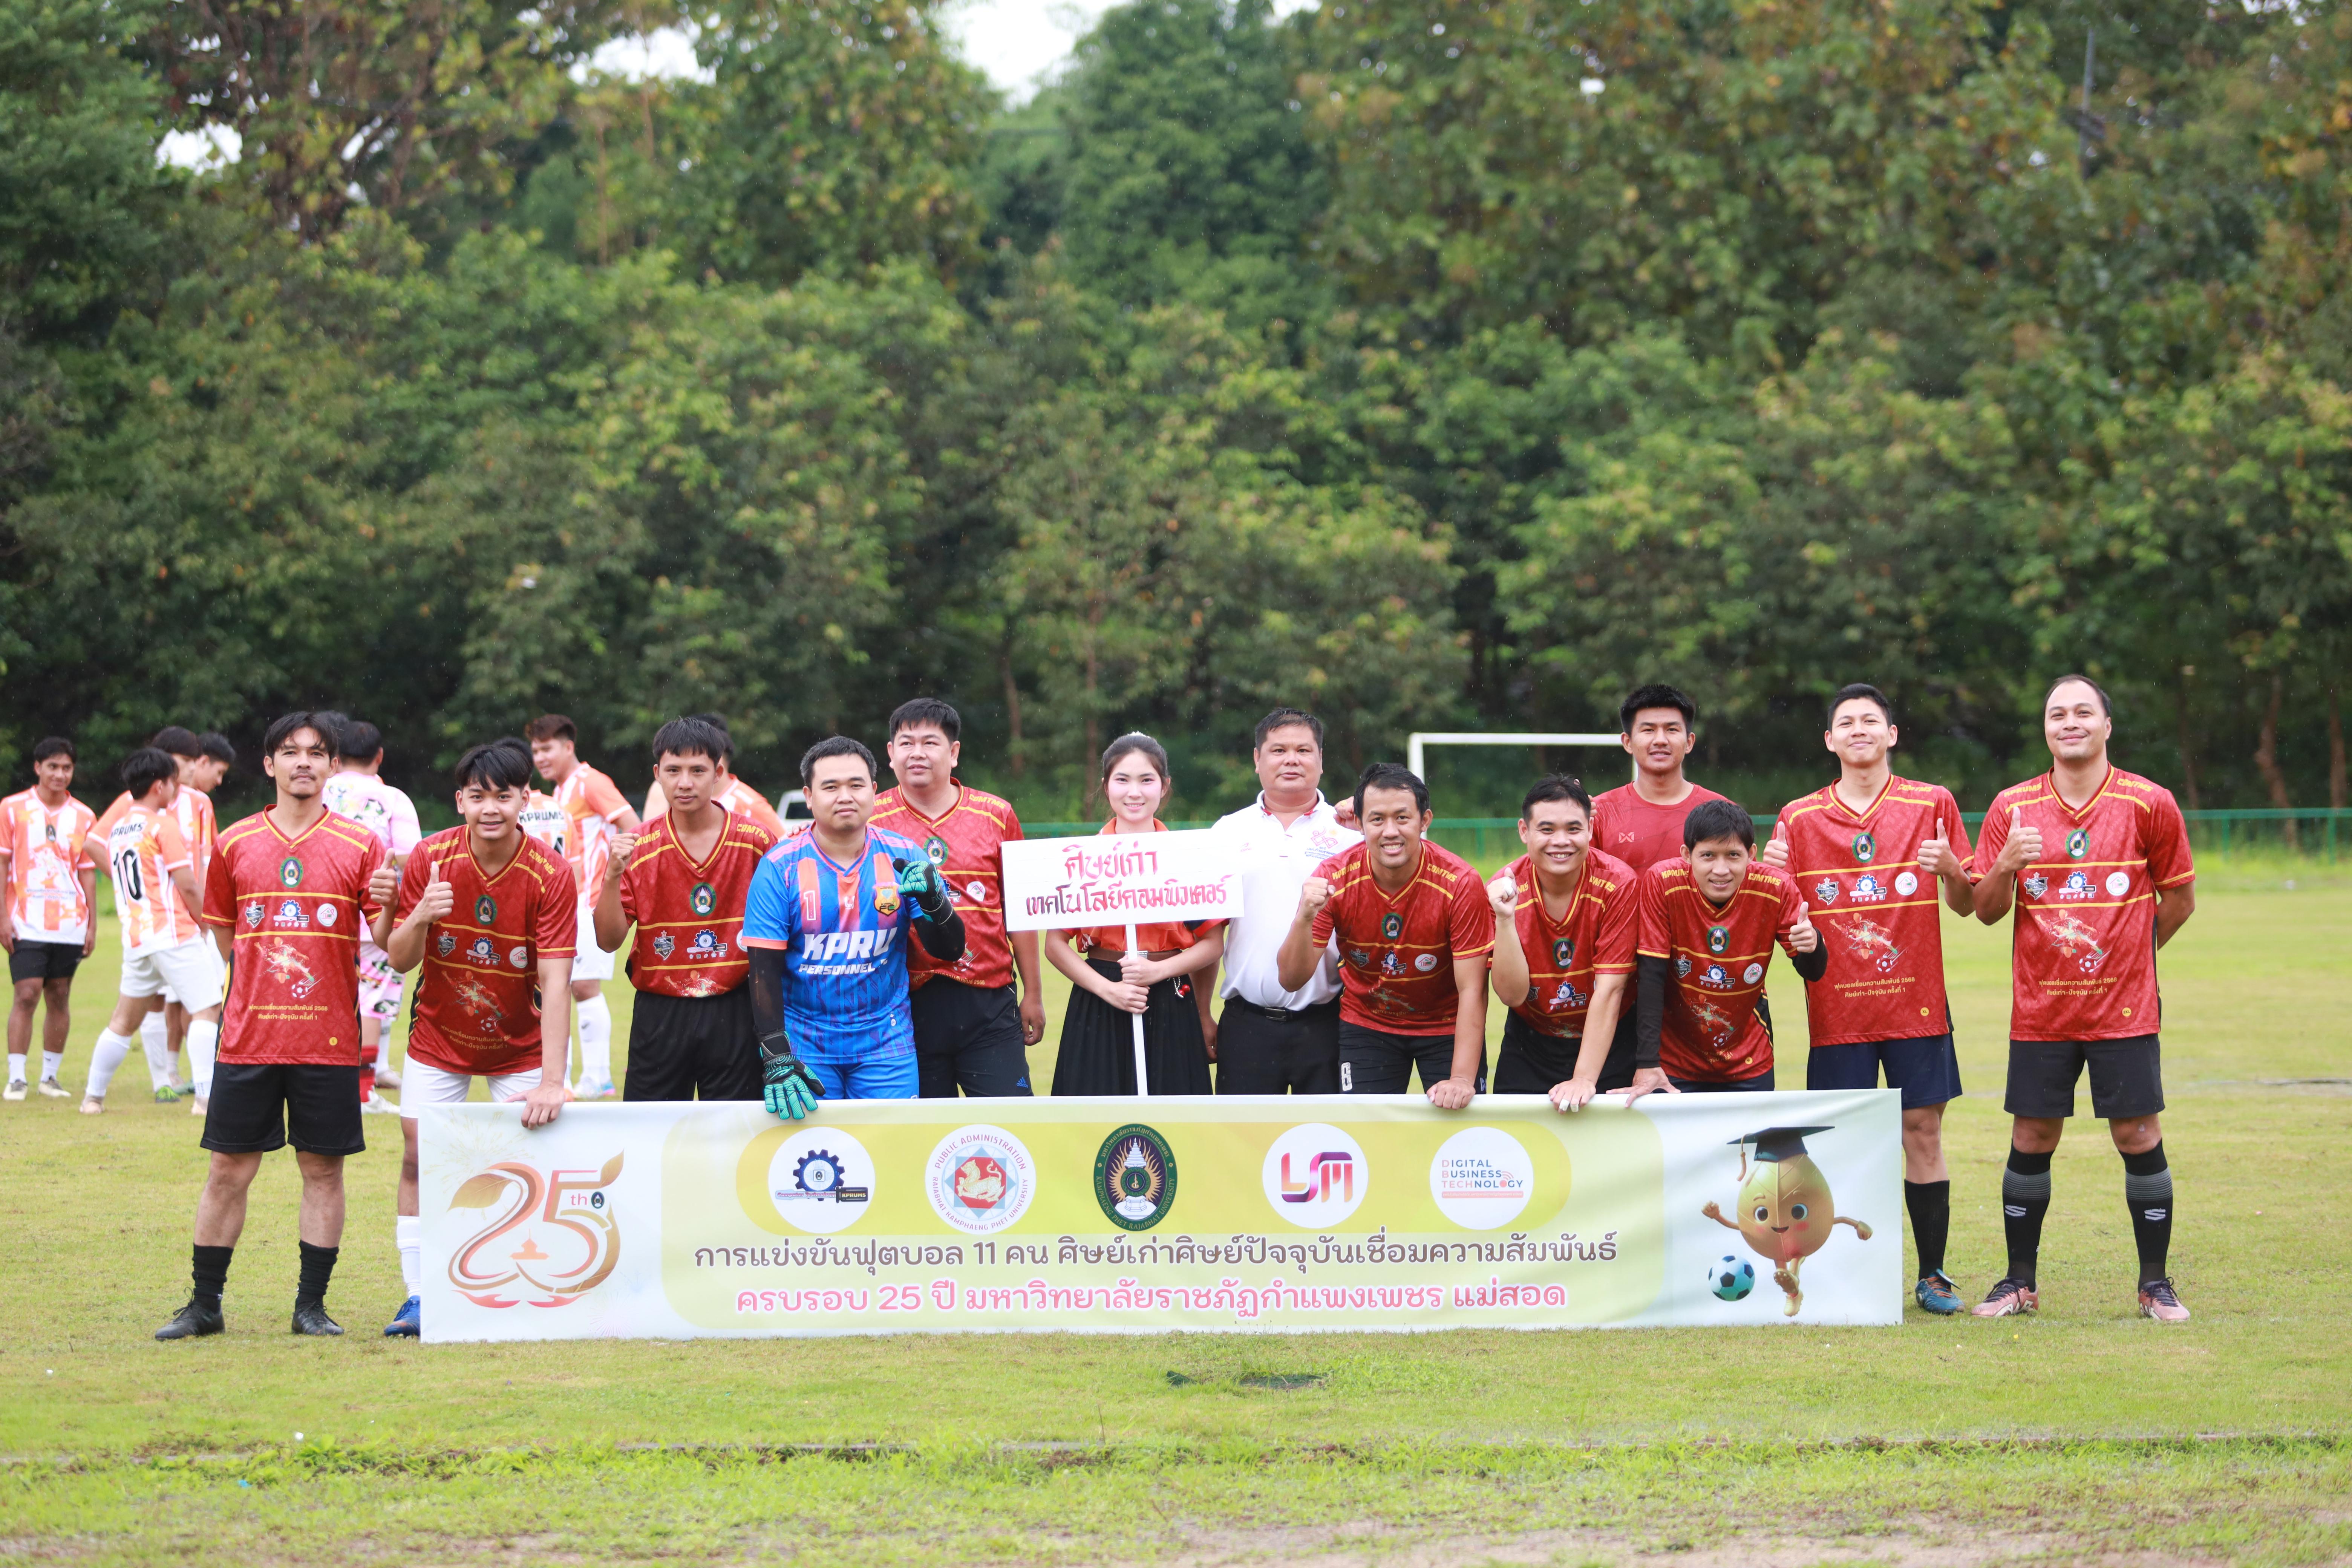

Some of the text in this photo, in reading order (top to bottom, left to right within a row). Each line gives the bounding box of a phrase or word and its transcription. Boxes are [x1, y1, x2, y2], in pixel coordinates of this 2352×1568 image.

[113, 849, 142, 905] 10
[1062, 839, 1159, 880] ศิษย์เก่า
[1747, 872, 1782, 887] COMTMS
[803, 890, 816, 920] 1
[802, 926, 898, 960] KPRU
[798, 962, 876, 975] PERSONNEL
[934, 1134, 1027, 1170] PUBLIC ADMINISTRATION
[1442, 1170, 1502, 1178] BUSINESS
[945, 1211, 989, 1231] KAMPHAENG
[991, 1217, 1008, 1229] PHET
[1009, 1179, 1028, 1218] UNIVERSITY
[1096, 1176, 1175, 1230] KAMPHAENG PHET RAJABHAT UNIVERSITY
[447, 1153, 624, 1294] 25 th
[695, 1226, 1618, 1276] การแข่งขันฟุตบอล 11 คน ศิษย์เก่าศิษย์ปัจจุบันเชื่อมความสัมพันธ์
[737, 1277, 1565, 1317] ครบรอบ 25 ปี มหาวิทยาลัยราชภัฏกำแพงเพชร แม่สอด
